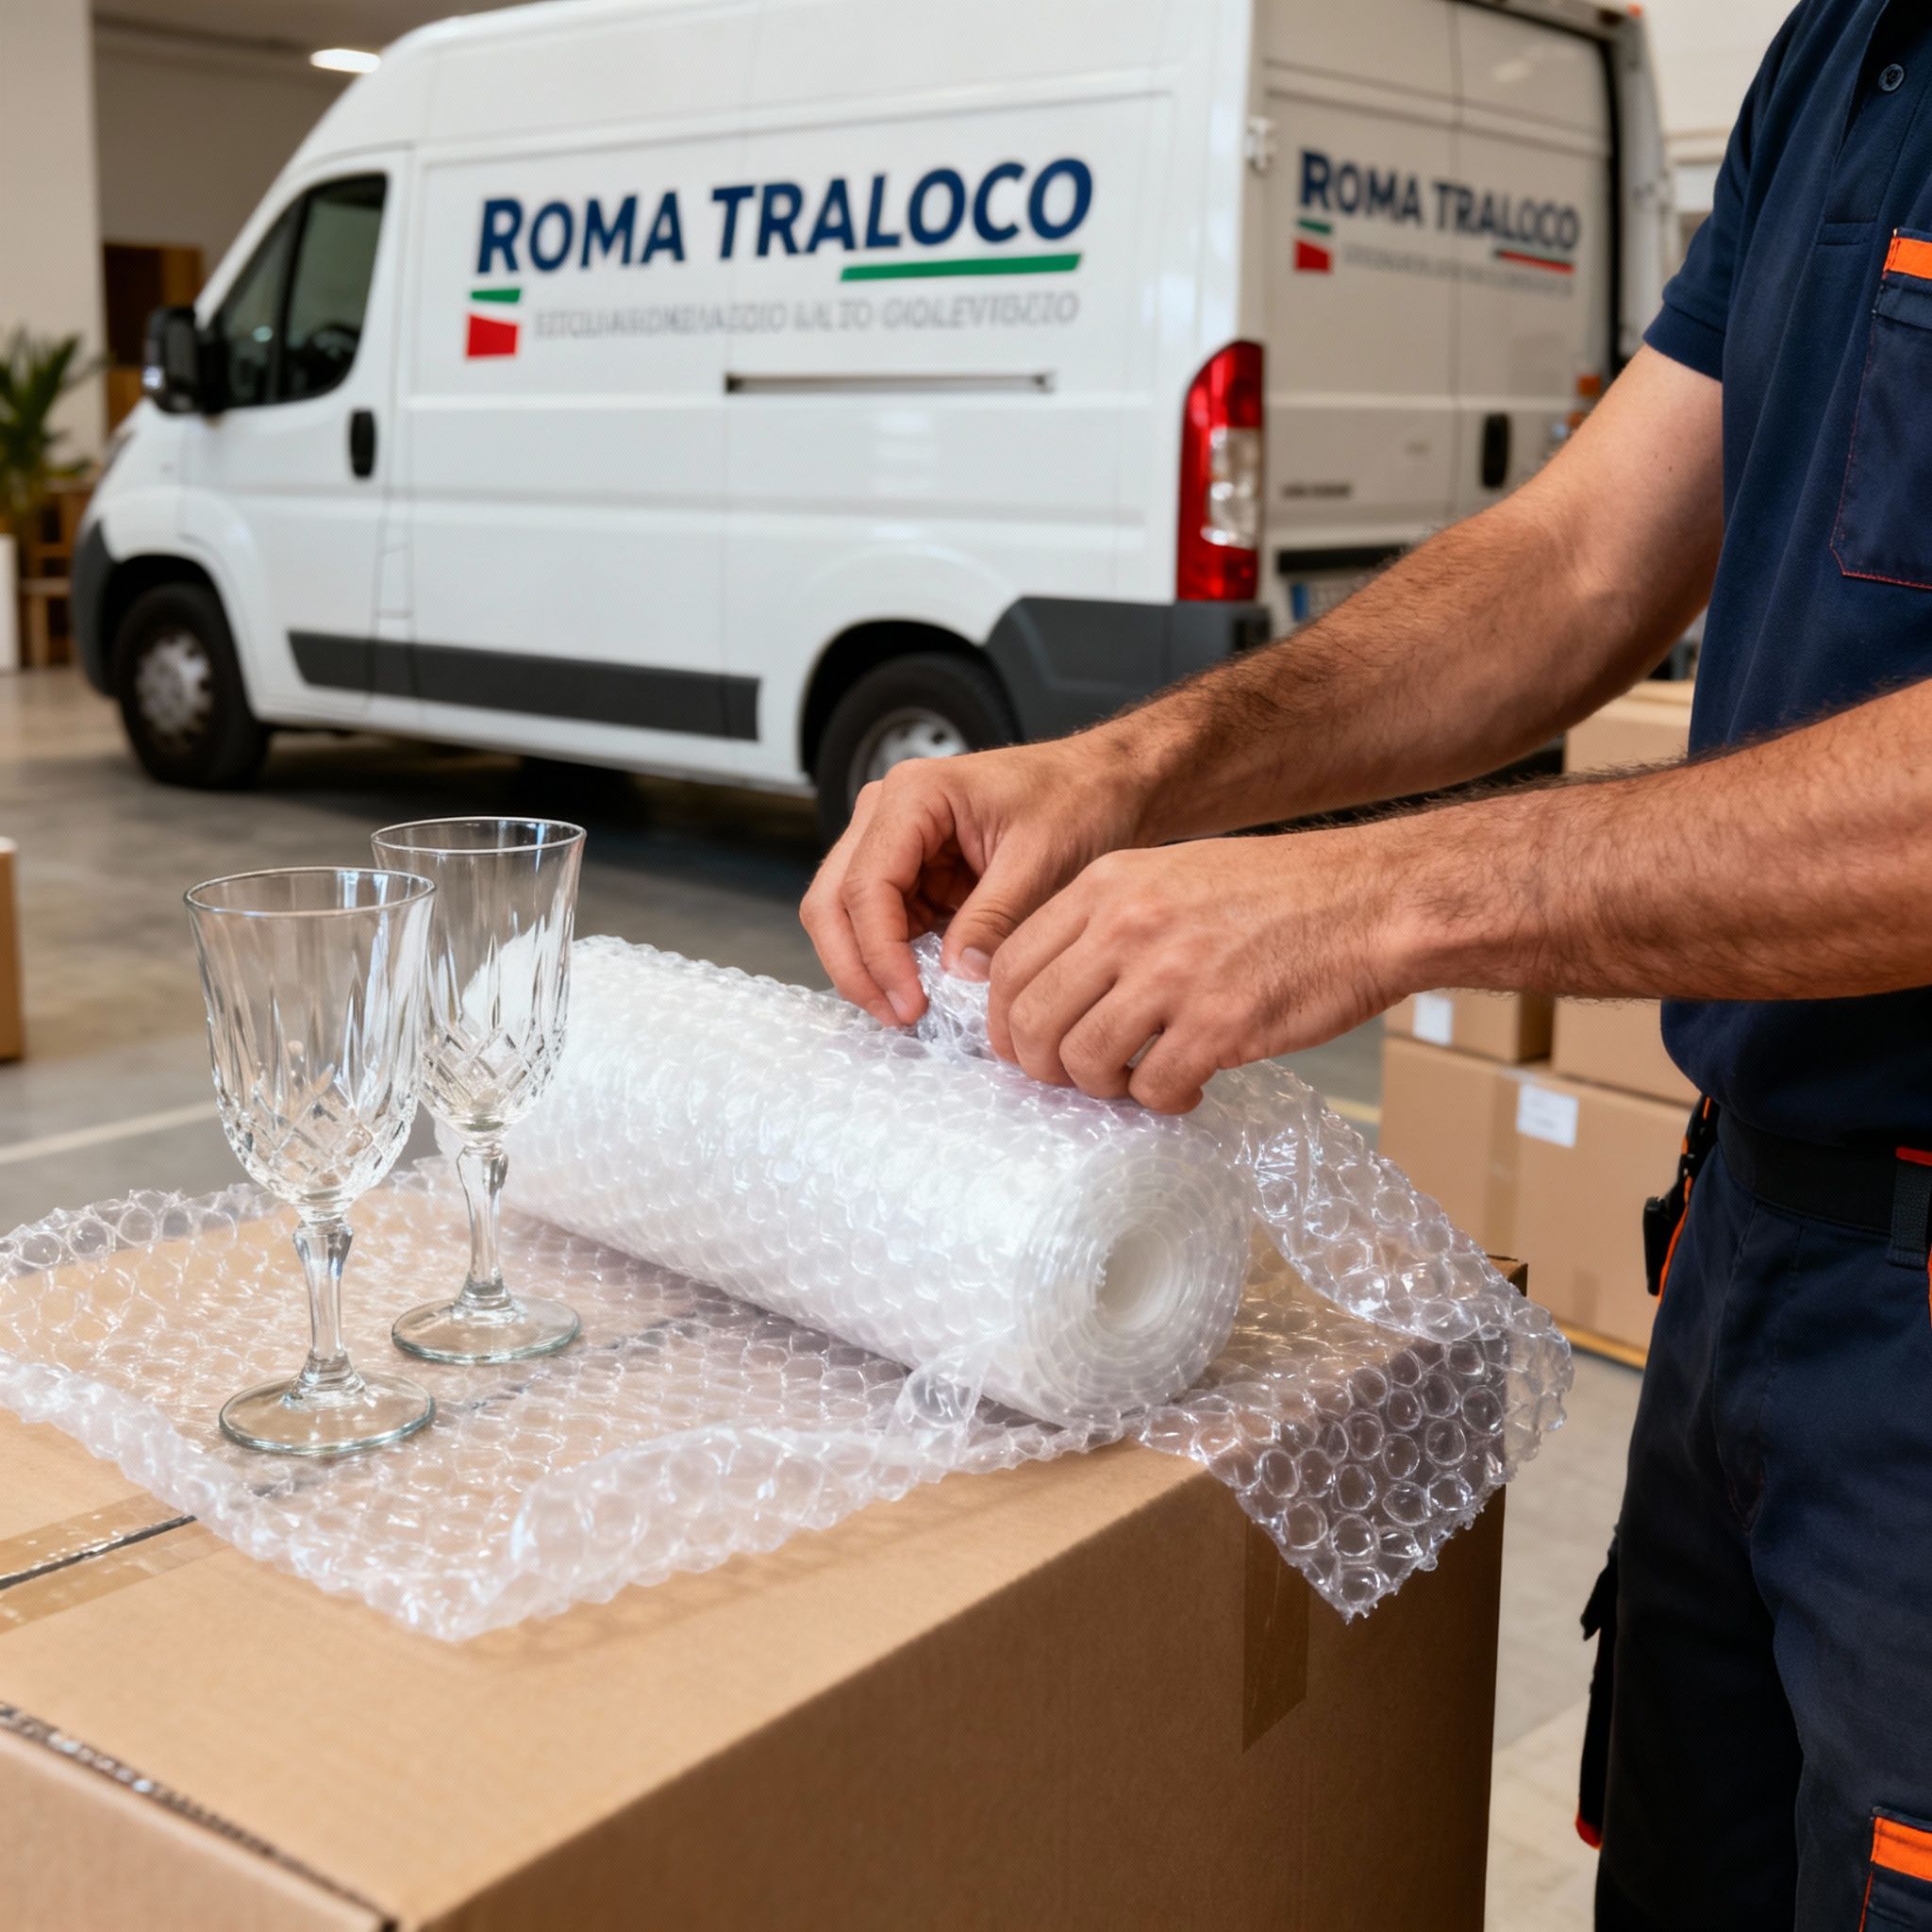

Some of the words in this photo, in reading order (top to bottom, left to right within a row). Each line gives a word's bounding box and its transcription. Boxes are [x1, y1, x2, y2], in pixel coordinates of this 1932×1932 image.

[475, 191, 686, 275] ROMA
[710, 158, 1094, 260] TRALOCO
[1298, 148, 1423, 225] ROMA
[1433, 180, 1581, 252] TRALOCO
